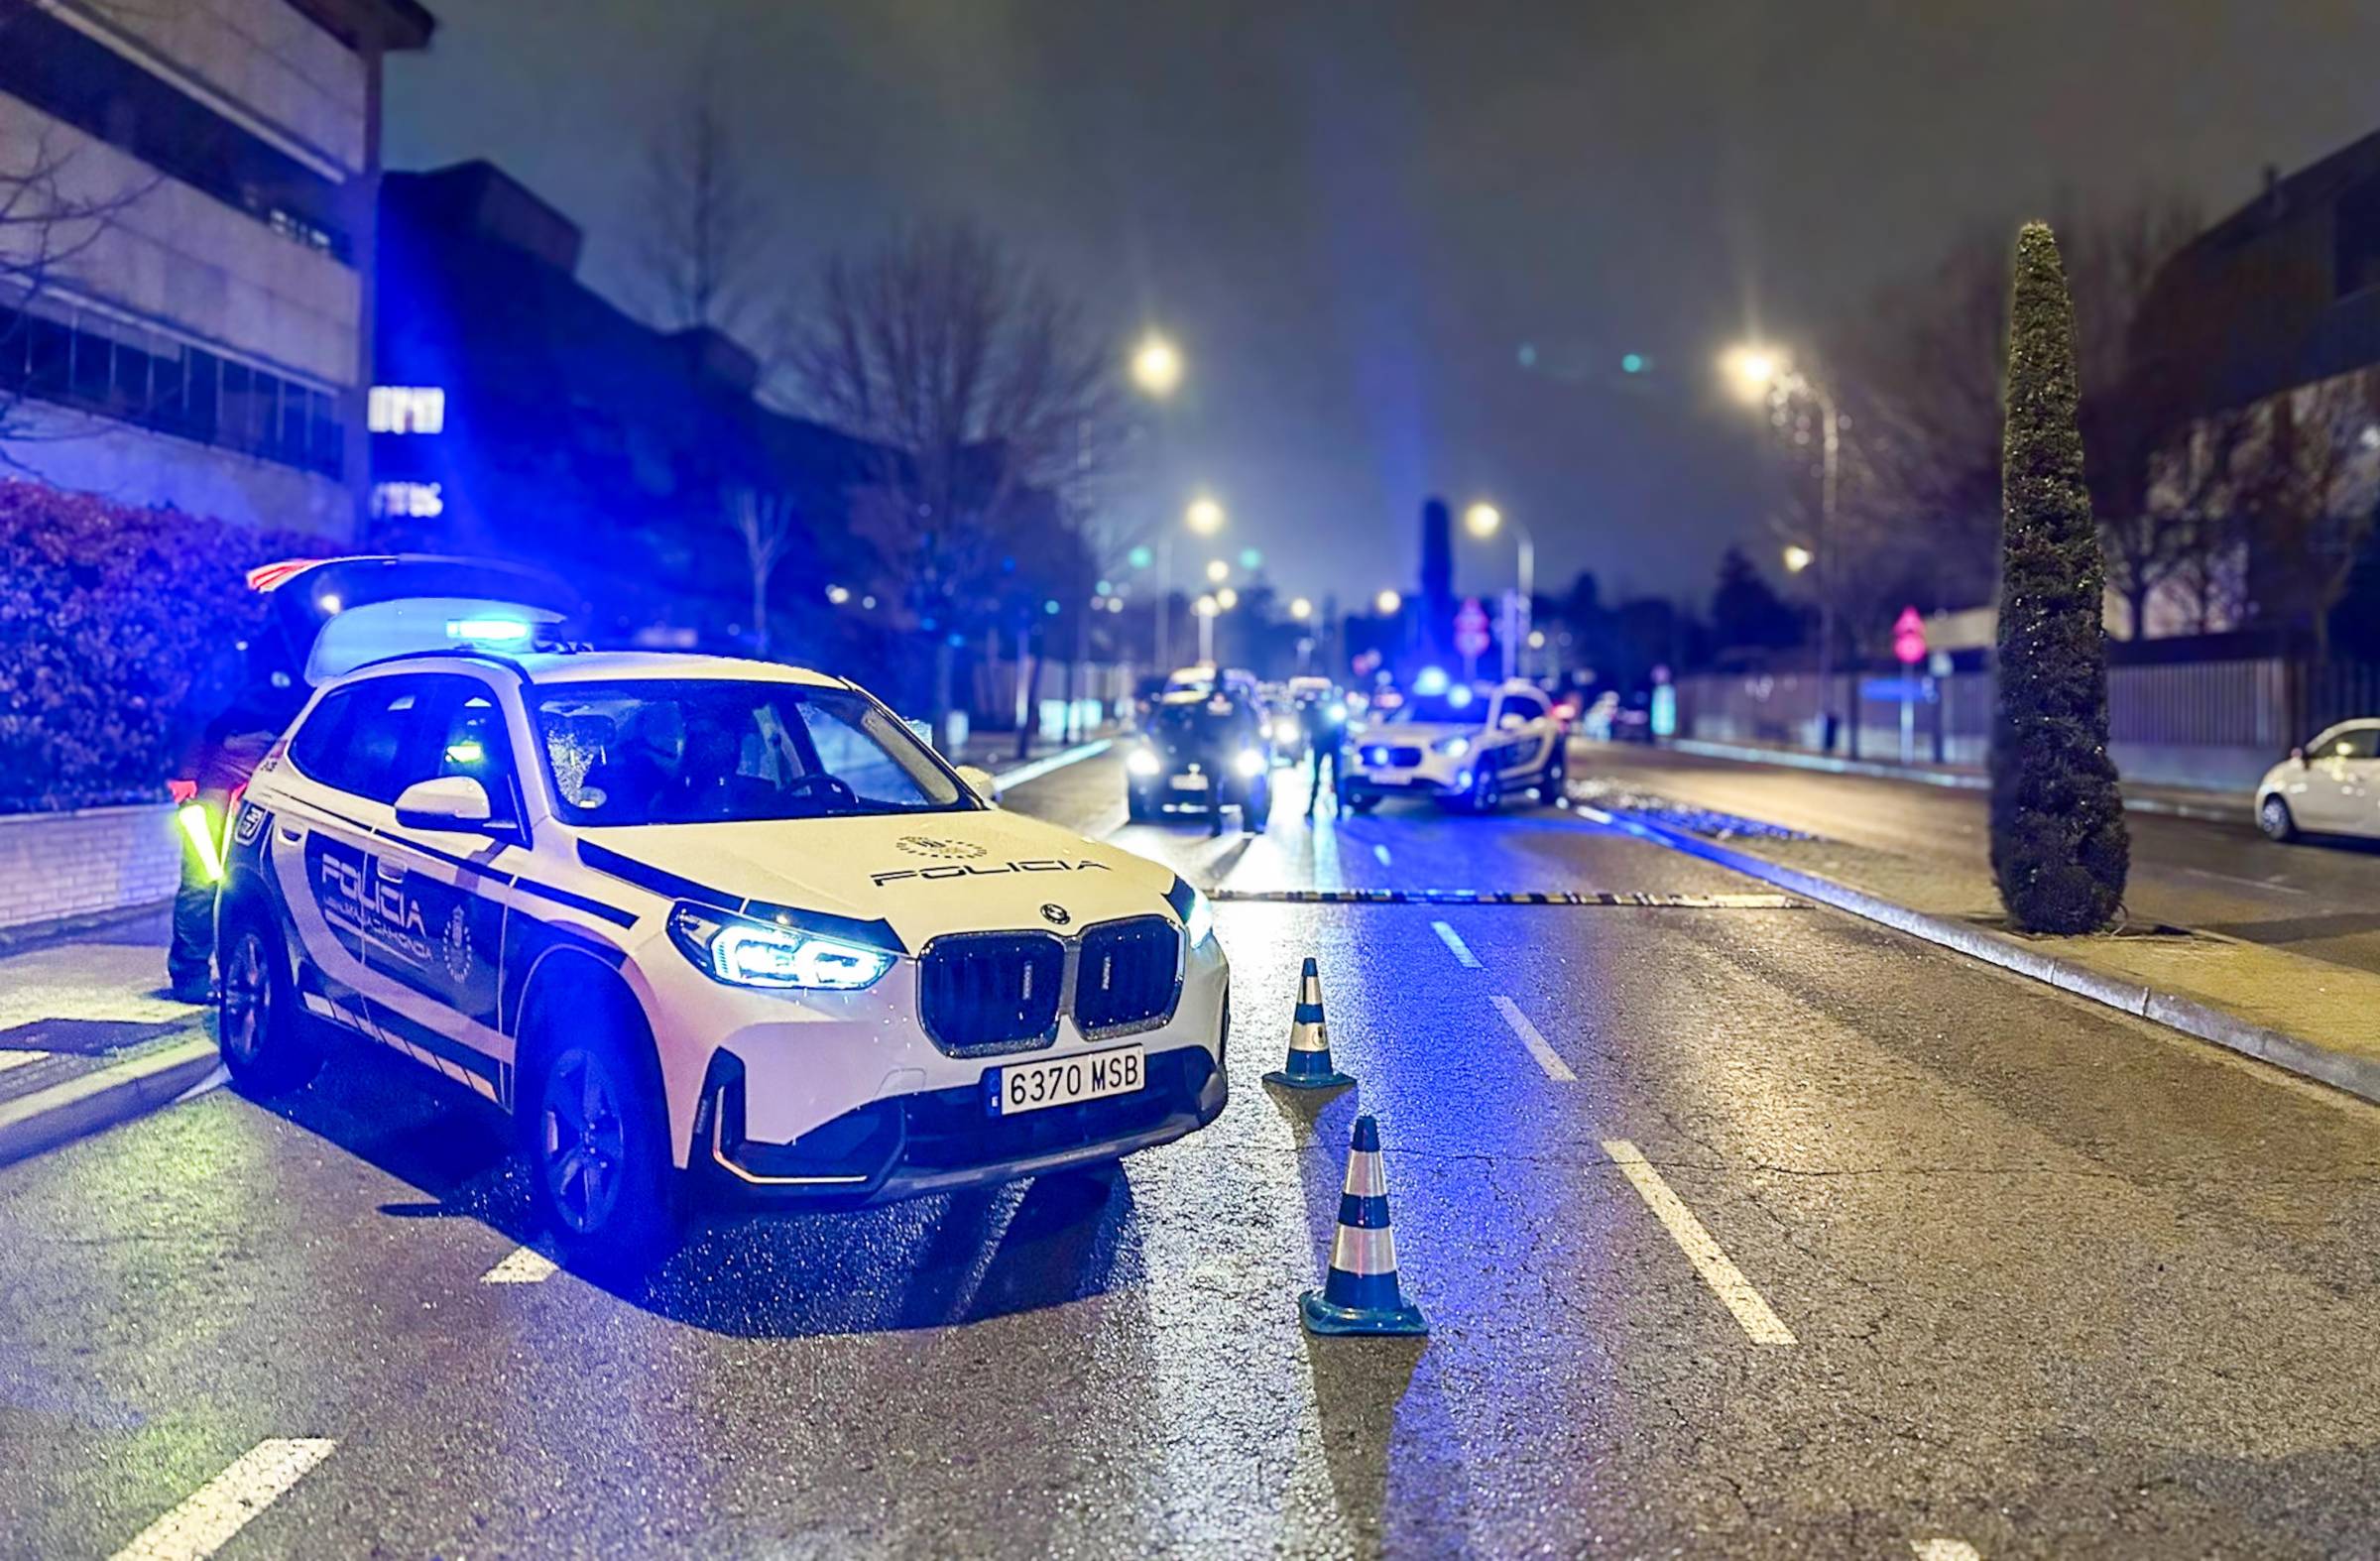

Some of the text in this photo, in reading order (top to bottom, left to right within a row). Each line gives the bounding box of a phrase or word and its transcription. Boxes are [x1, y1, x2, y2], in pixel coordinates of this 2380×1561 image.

[322, 853, 426, 938] POLICIA
[870, 860, 1113, 887] POLICIA
[1011, 1054, 1138, 1105] 6370 MSB
